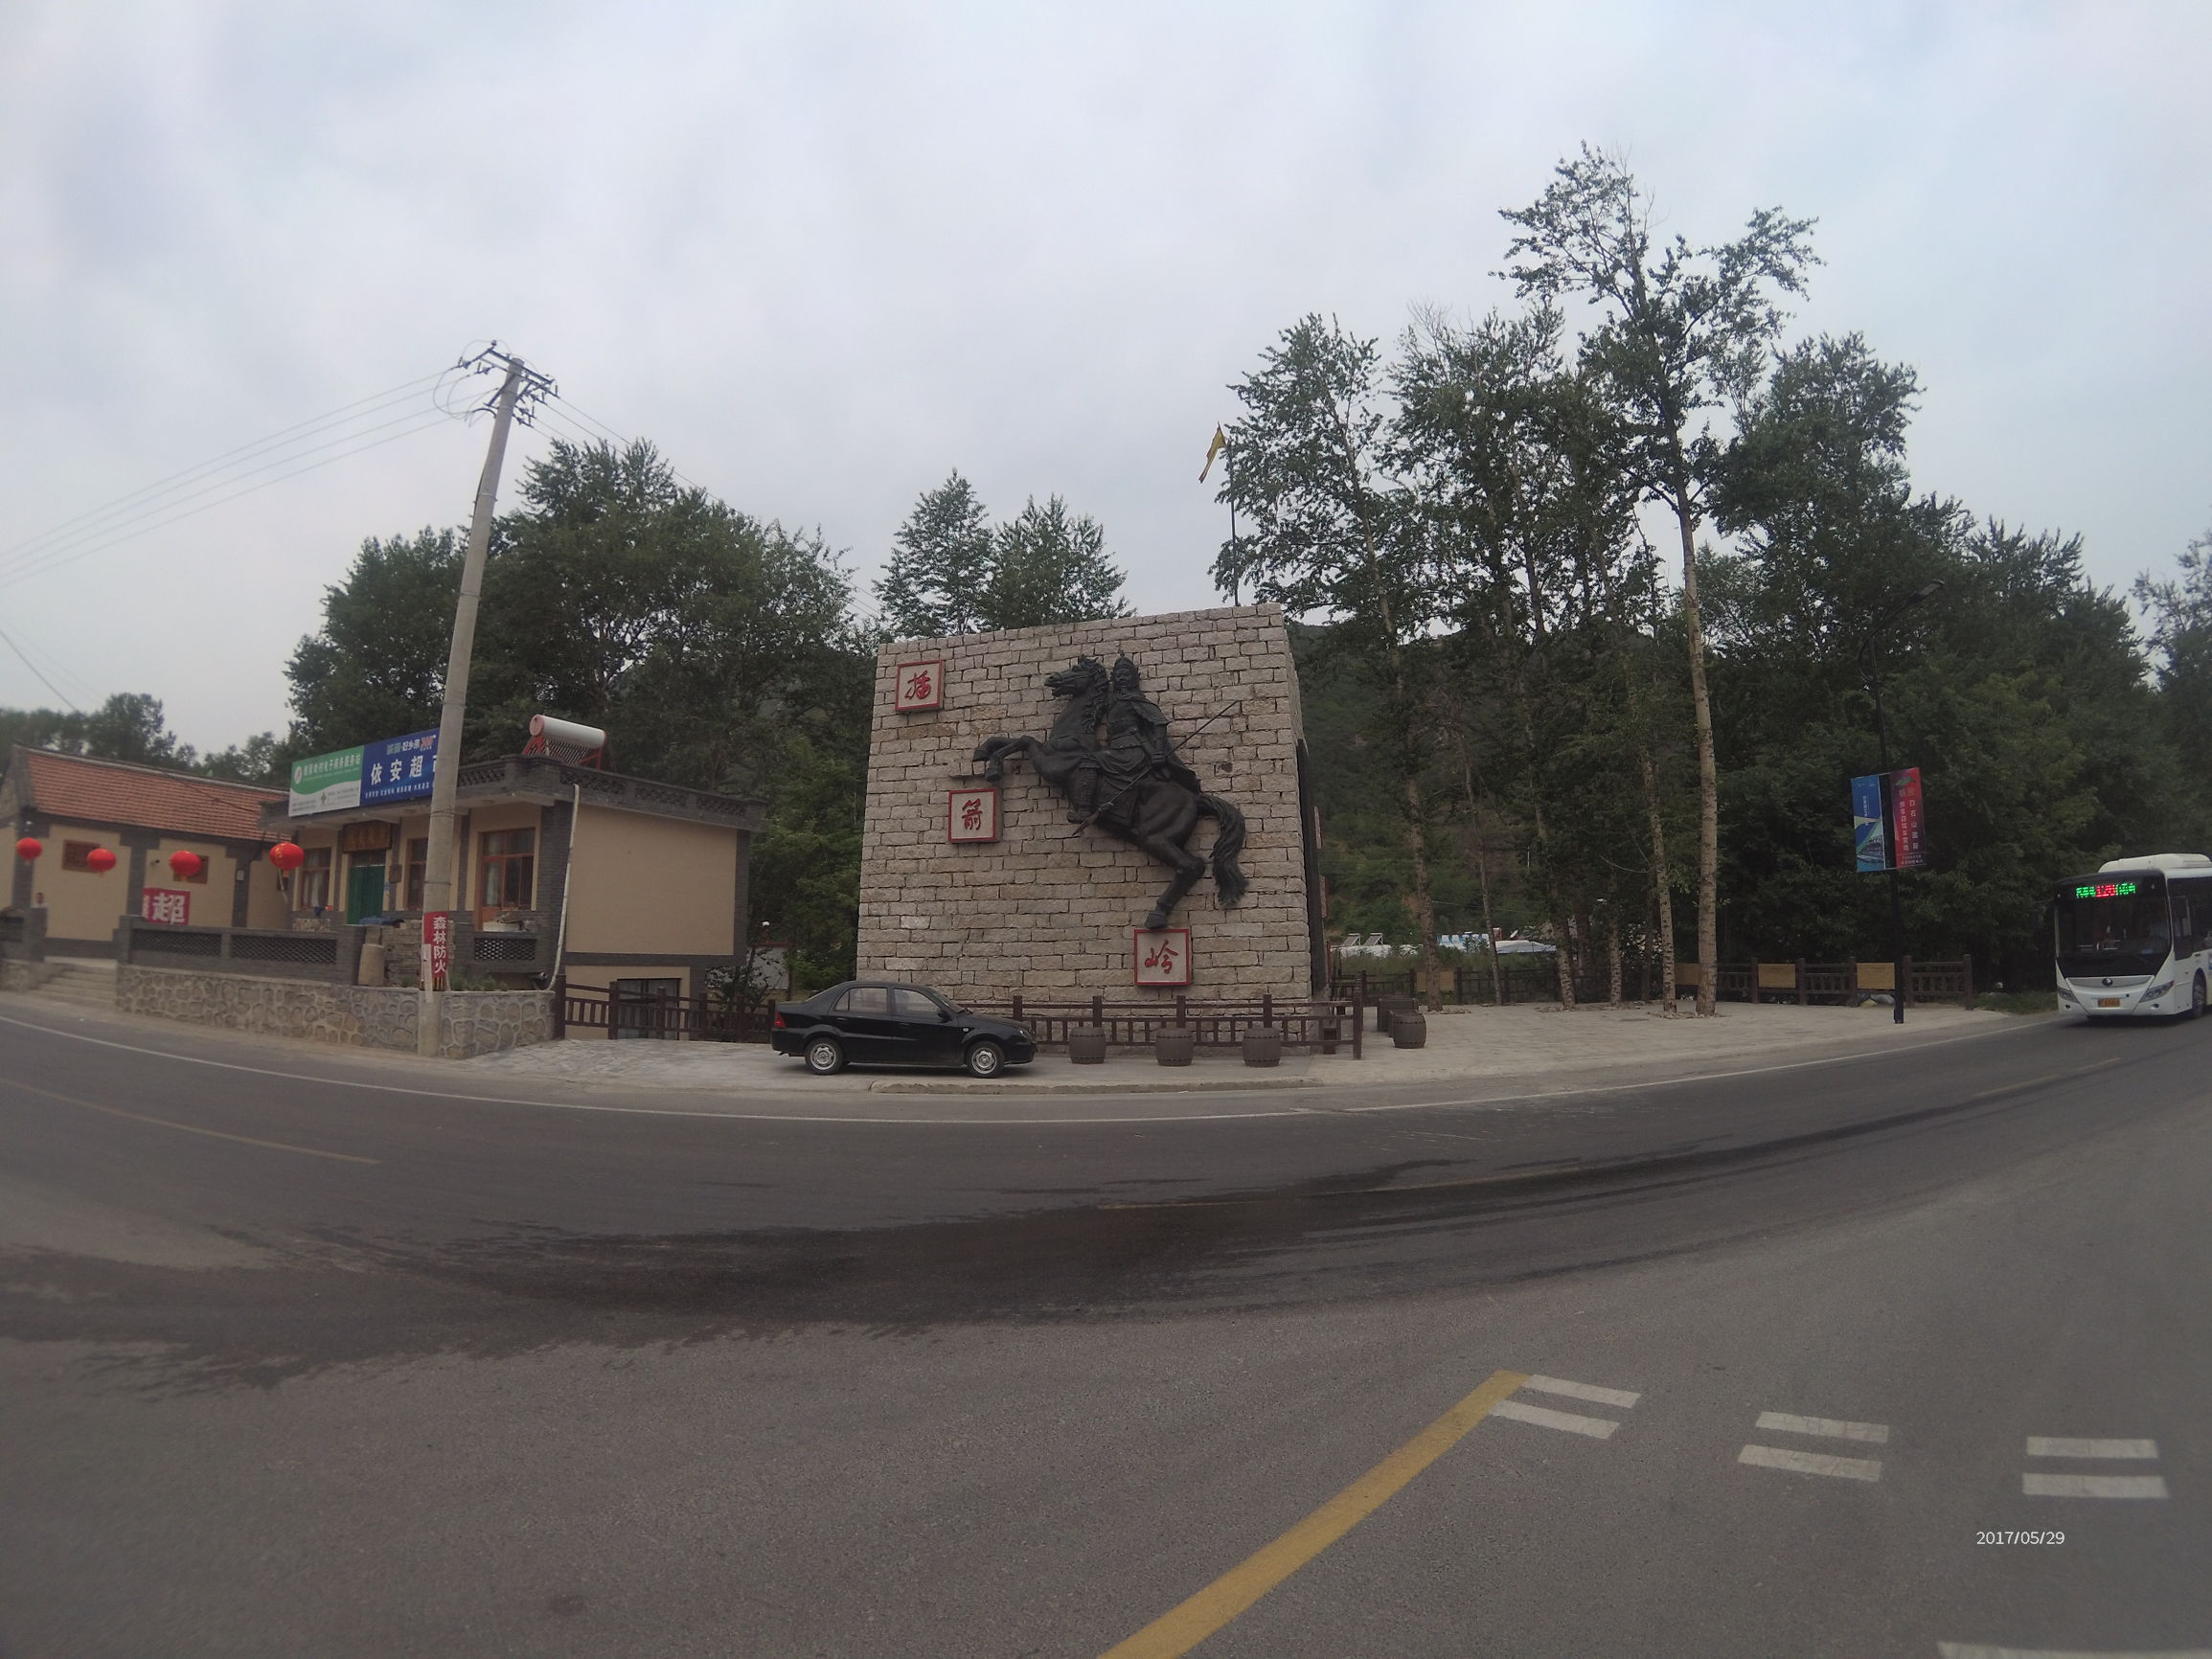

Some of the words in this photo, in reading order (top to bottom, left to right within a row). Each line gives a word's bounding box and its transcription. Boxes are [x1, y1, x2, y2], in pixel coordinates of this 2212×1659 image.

[904, 670, 931, 699] 插
[962, 798, 983, 830] 箭
[1144, 939, 1179, 974] 岭
[433, 916, 447, 973] 森林防火
